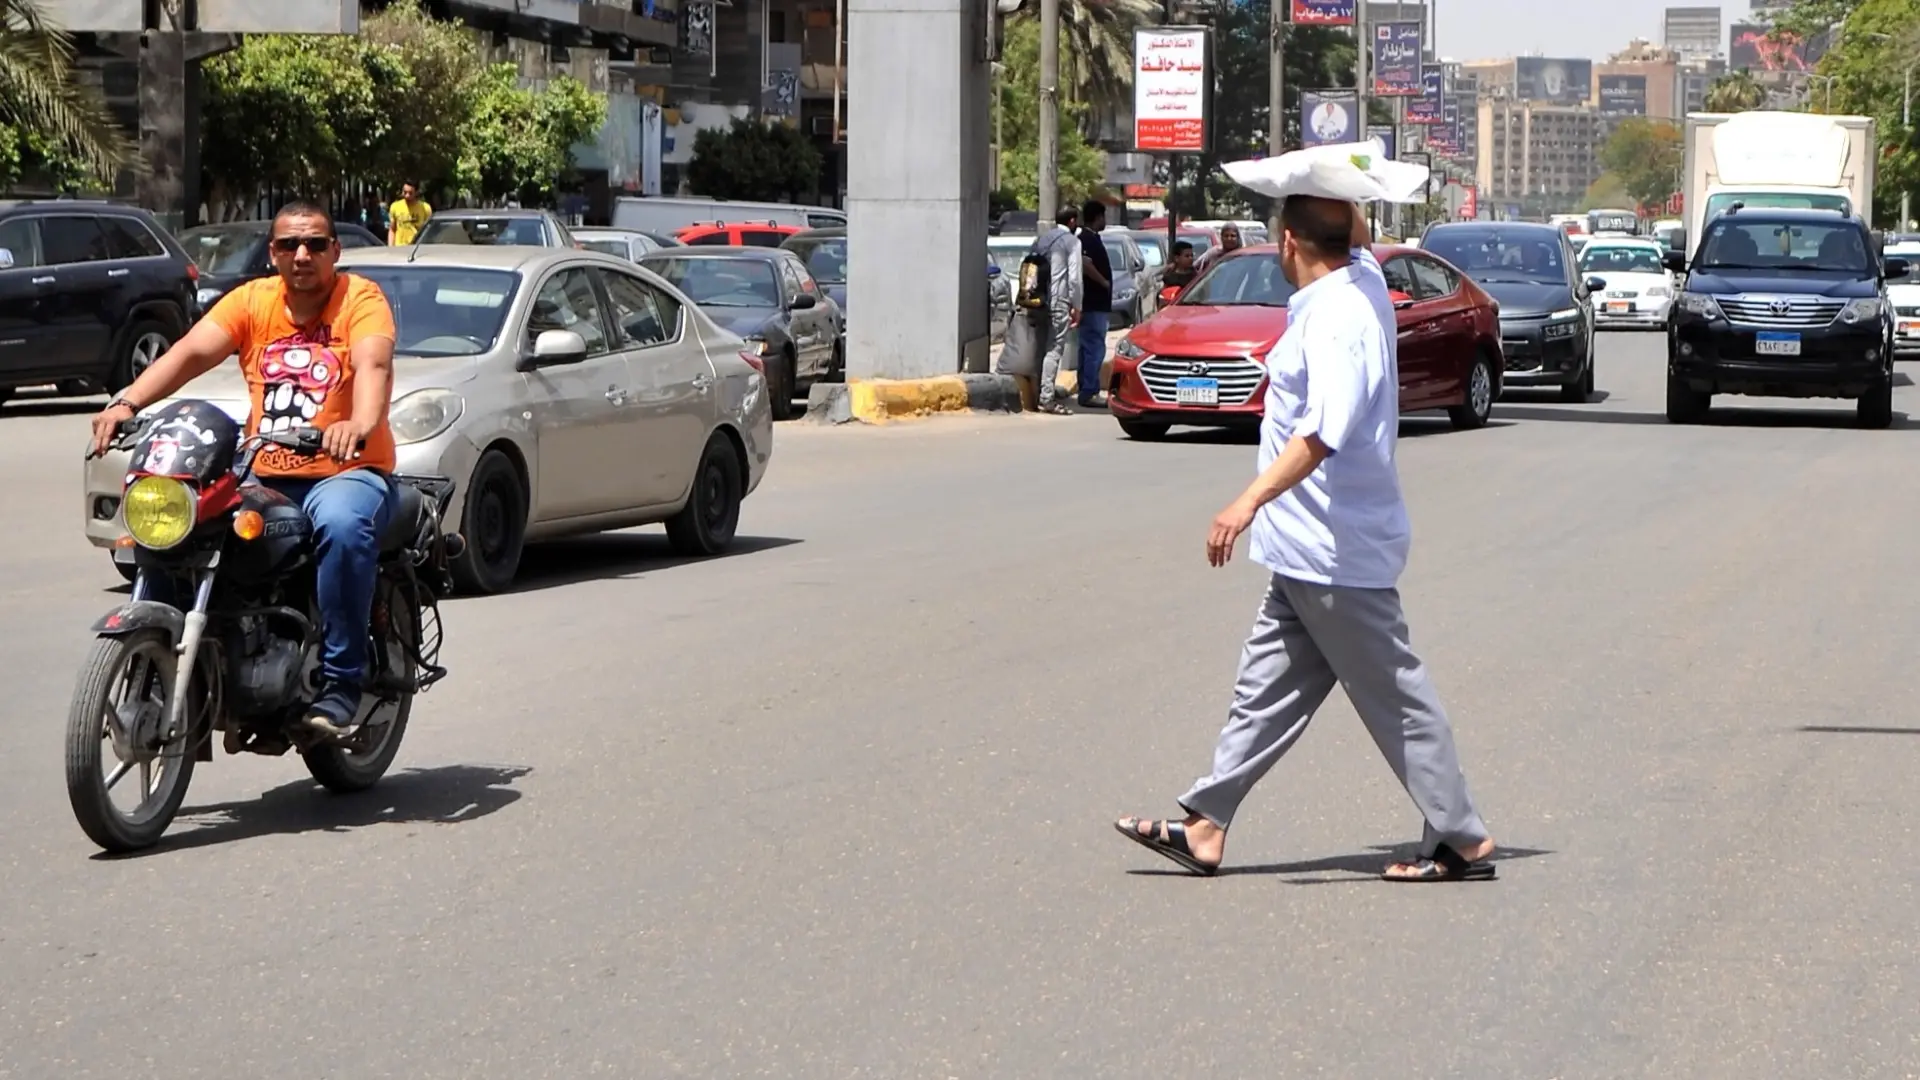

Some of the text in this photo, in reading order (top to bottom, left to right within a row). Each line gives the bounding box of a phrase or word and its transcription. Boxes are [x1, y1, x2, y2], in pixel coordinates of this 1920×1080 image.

[1296, 7, 1323, 20] شهاب
[1141, 54, 1202, 76] سيد حافظ
